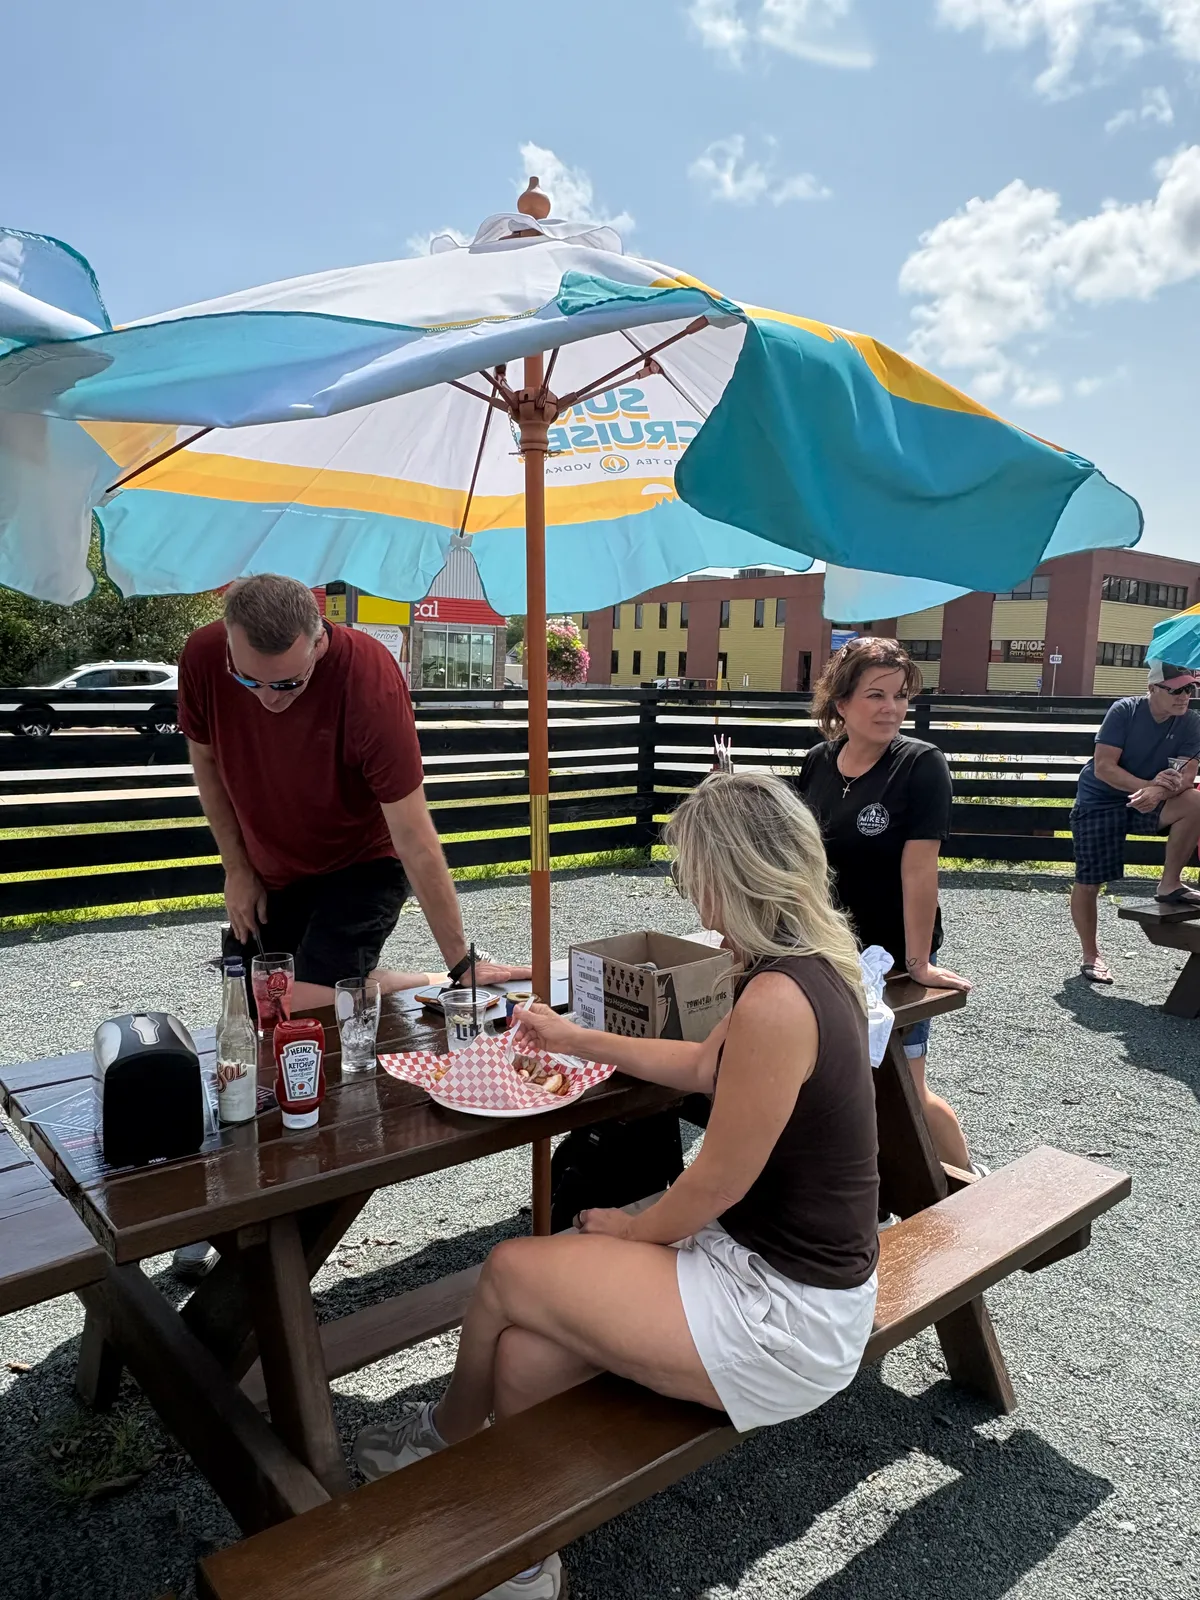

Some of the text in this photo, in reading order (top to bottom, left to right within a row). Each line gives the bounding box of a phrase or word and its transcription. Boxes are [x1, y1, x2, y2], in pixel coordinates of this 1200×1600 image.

[290, 1046, 313, 1056] HEINZ
[288, 1060, 315, 1069] KETCHUP
[217, 1062, 248, 1094] SOL
